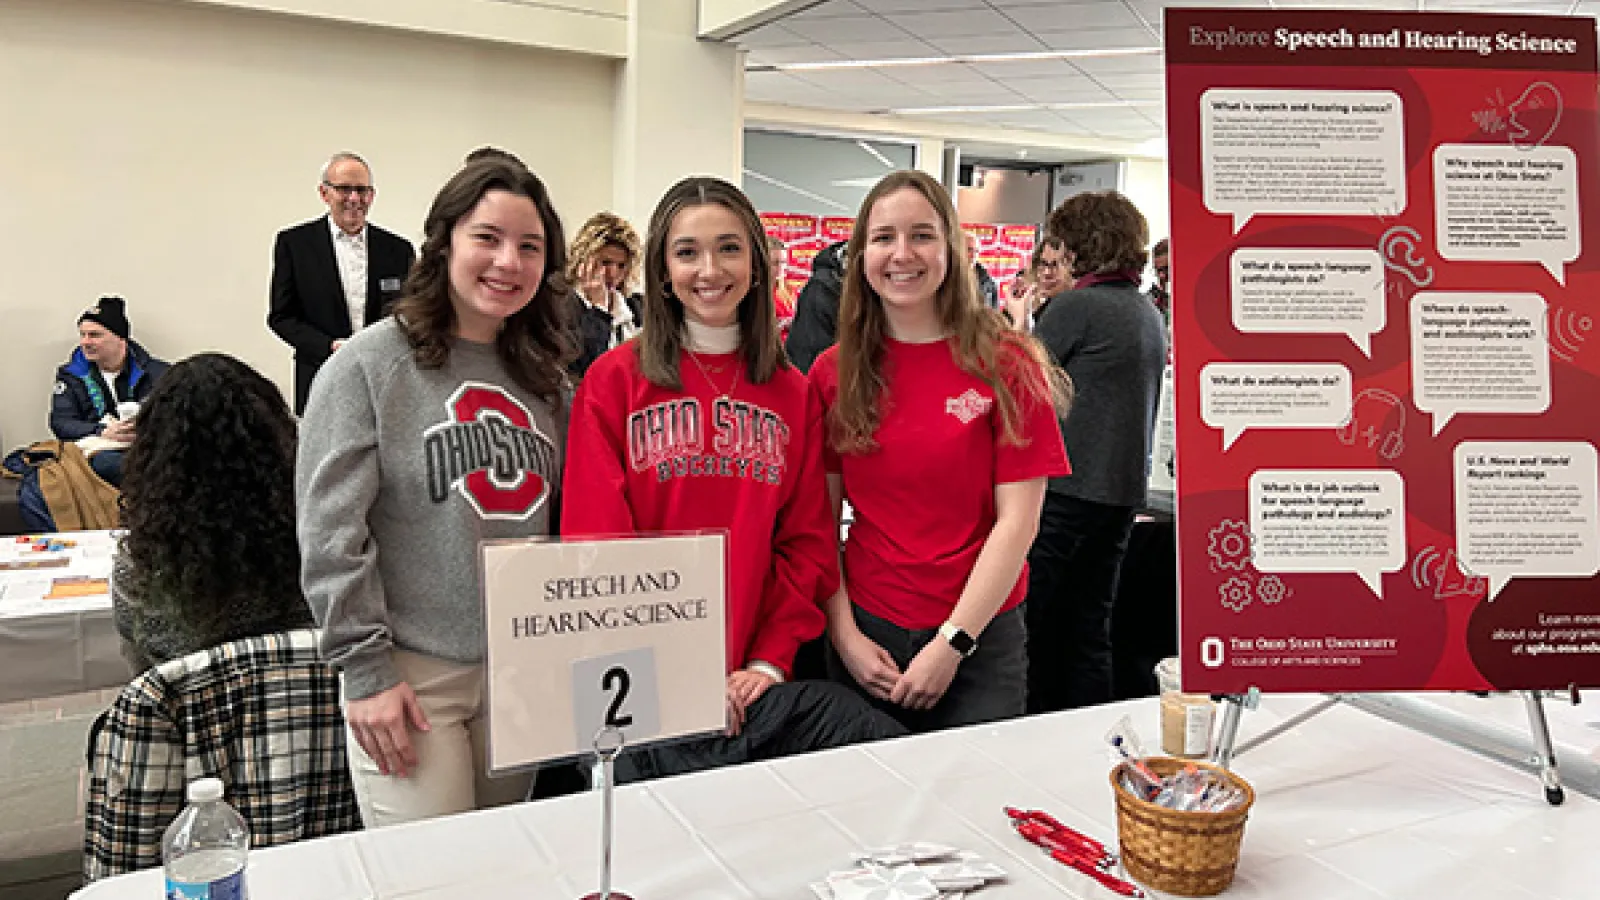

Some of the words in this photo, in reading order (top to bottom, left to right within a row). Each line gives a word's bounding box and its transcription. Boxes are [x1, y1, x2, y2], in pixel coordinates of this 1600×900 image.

[1189, 26, 1269, 50] Explore
[1274, 28, 1353, 52] Speech
[1358, 29, 1400, 48] and
[1405, 30, 1492, 55] Hearing
[1495, 30, 1577, 53] Science
[1211, 102, 1240, 111] What
[1243, 102, 1251, 111] is
[1253, 102, 1288, 113] speech
[1290, 102, 1310, 112] and
[1312, 102, 1349, 114] hearing
[1352, 103, 1393, 113] science?
[1445, 159, 1467, 169] Why
[1471, 159, 1504, 169] speech
[1507, 159, 1525, 169] and
[1527, 160, 1564, 171] hearing
[1445, 171, 1481, 180] science
[1496, 170, 1518, 180] Ohio
[1520, 171, 1552, 181] State?
[1240, 260, 1270, 270] What
[1272, 260, 1286, 270] do
[1241, 274, 1305, 285] pathologists
[1306, 273, 1326, 284] do?
[1421, 303, 1454, 313] Where
[1457, 303, 1470, 313] do
[1421, 316, 1467, 328] language
[1469, 316, 1531, 328] pathologists
[1423, 330, 1441, 339] and
[1444, 330, 1504, 341] audiologists
[1506, 330, 1537, 340] work?
[1210, 375, 1240, 386] What
[1242, 375, 1257, 386] do
[1258, 376, 1319, 389] audiologists
[1321, 375, 1341, 387] do?
[626, 397, 705, 474] OHIO
[1490, 455, 1516, 466] News
[1519, 455, 1537, 466] and
[1539, 455, 1571, 466] World
[656, 455, 782, 486] BUCKEYES
[1466, 469, 1502, 480] Report
[1503, 469, 1547, 480] rankings
[1261, 482, 1290, 492] What
[1293, 482, 1302, 492] is
[1303, 482, 1321, 492] the
[1322, 482, 1340, 495] job
[1341, 482, 1380, 493] outlook
[1261, 495, 1278, 506] for
[1261, 508, 1313, 520] pathology
[1316, 508, 1334, 519] and
[1338, 508, 1393, 520] audiology?
[543, 574, 625, 603] SPEECH
[631, 569, 682, 595] AND
[512, 605, 620, 640] HEARING
[622, 598, 709, 628] SCIENCE
[1538, 612, 1571, 625] Learn
[1492, 628, 1526, 640] about
[1527, 628, 1548, 640] our
[601, 664, 633, 729] 2
